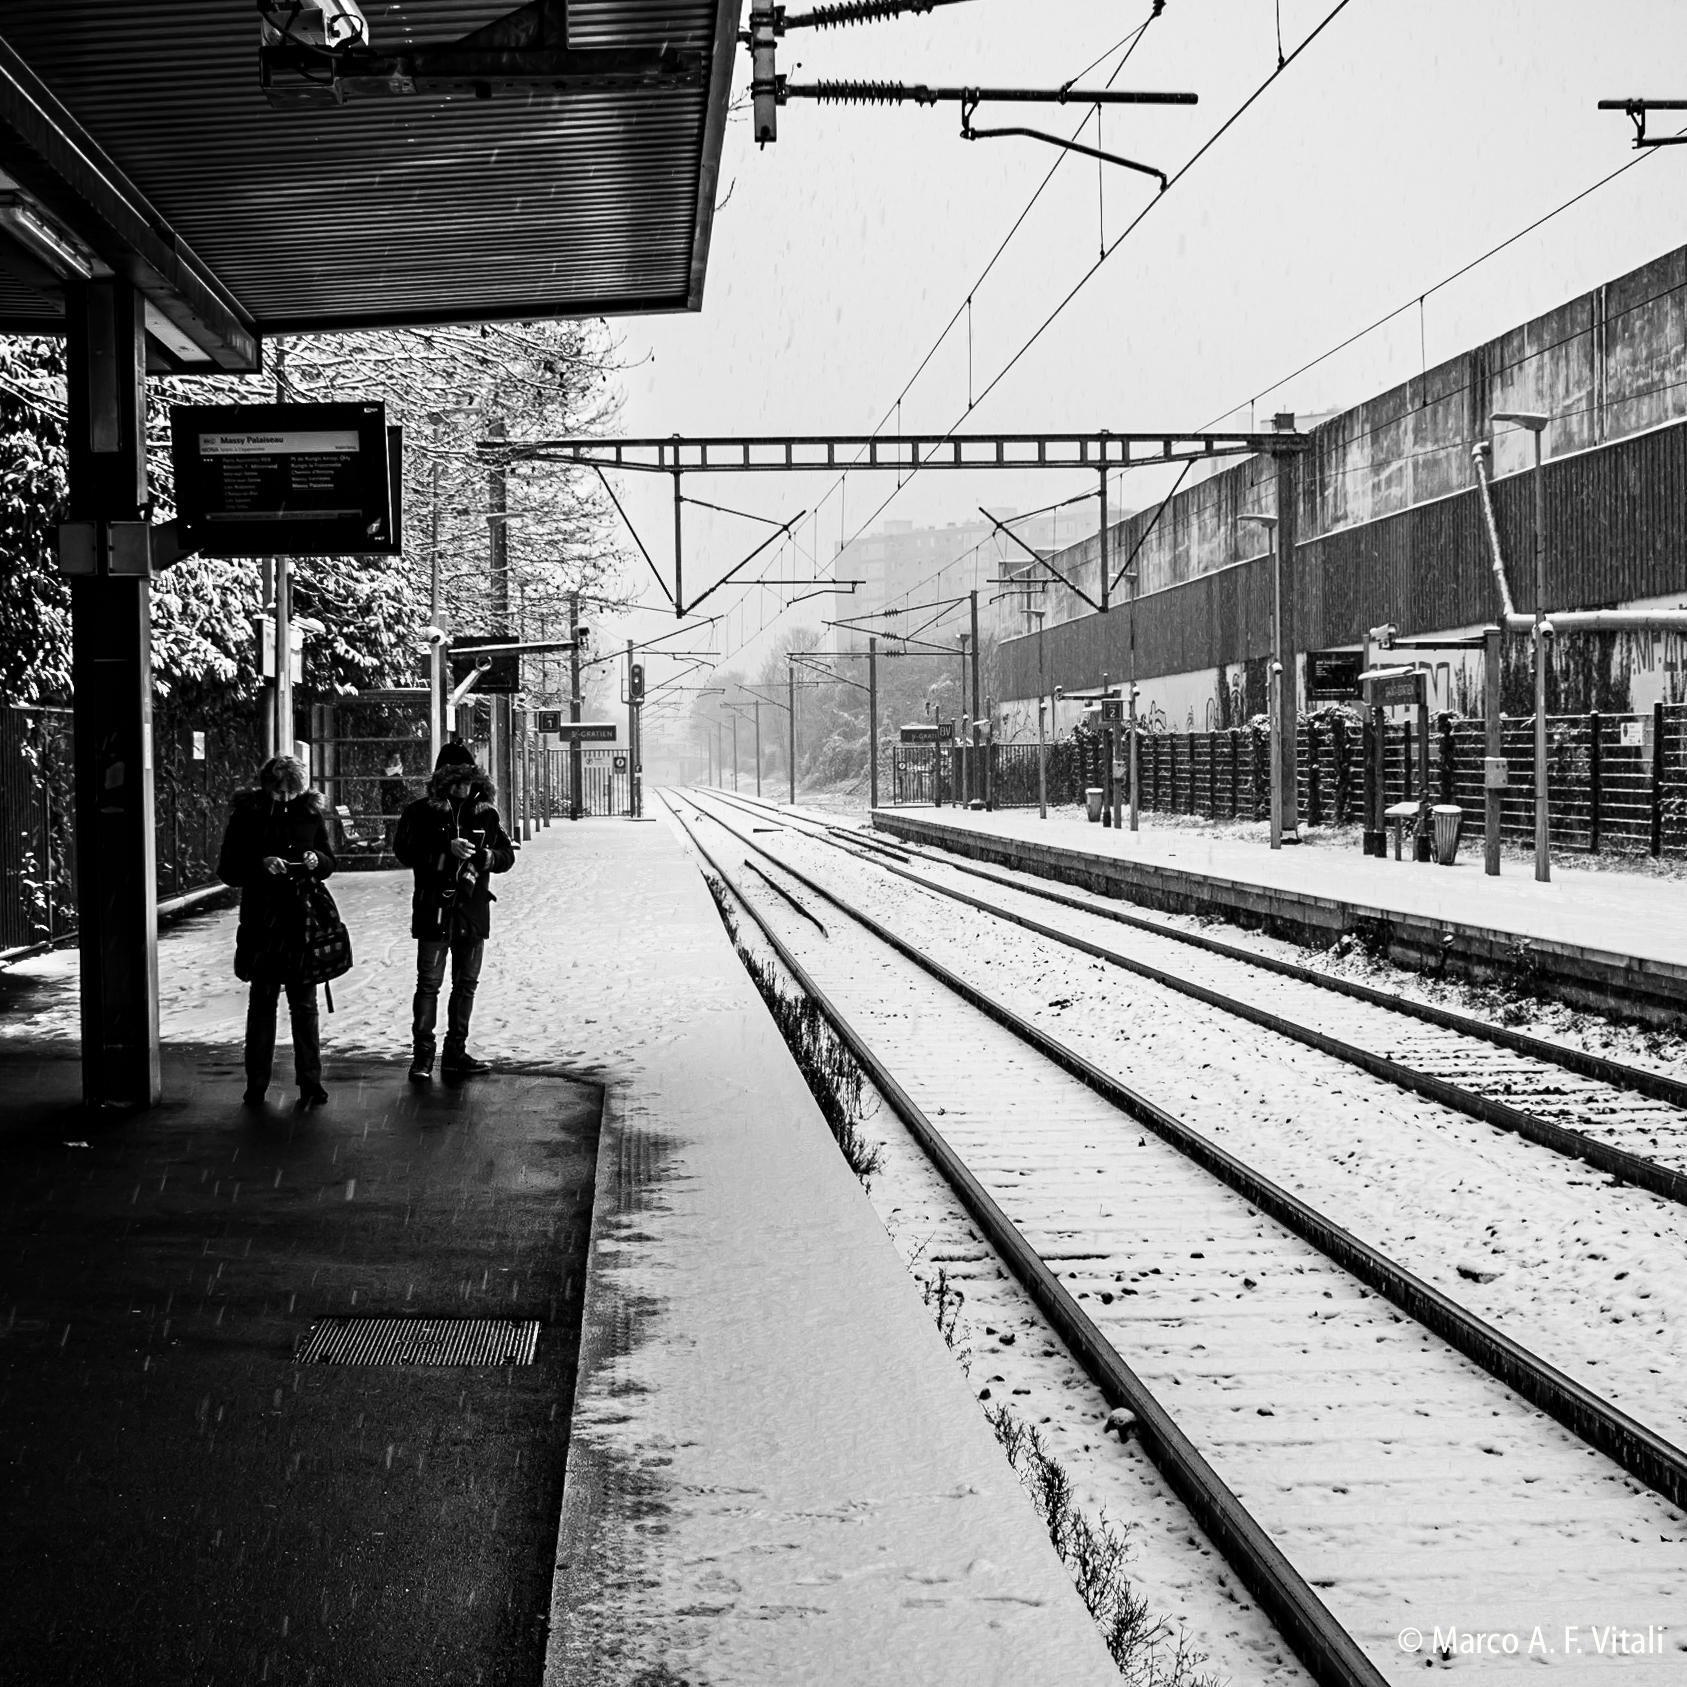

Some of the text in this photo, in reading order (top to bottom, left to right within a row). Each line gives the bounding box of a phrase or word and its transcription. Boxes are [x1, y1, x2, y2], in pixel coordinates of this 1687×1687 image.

[220, 436, 284, 445] Massy Palaiseau
[1110, 709, 1115, 718] 2
[547, 719, 552, 728] 1
